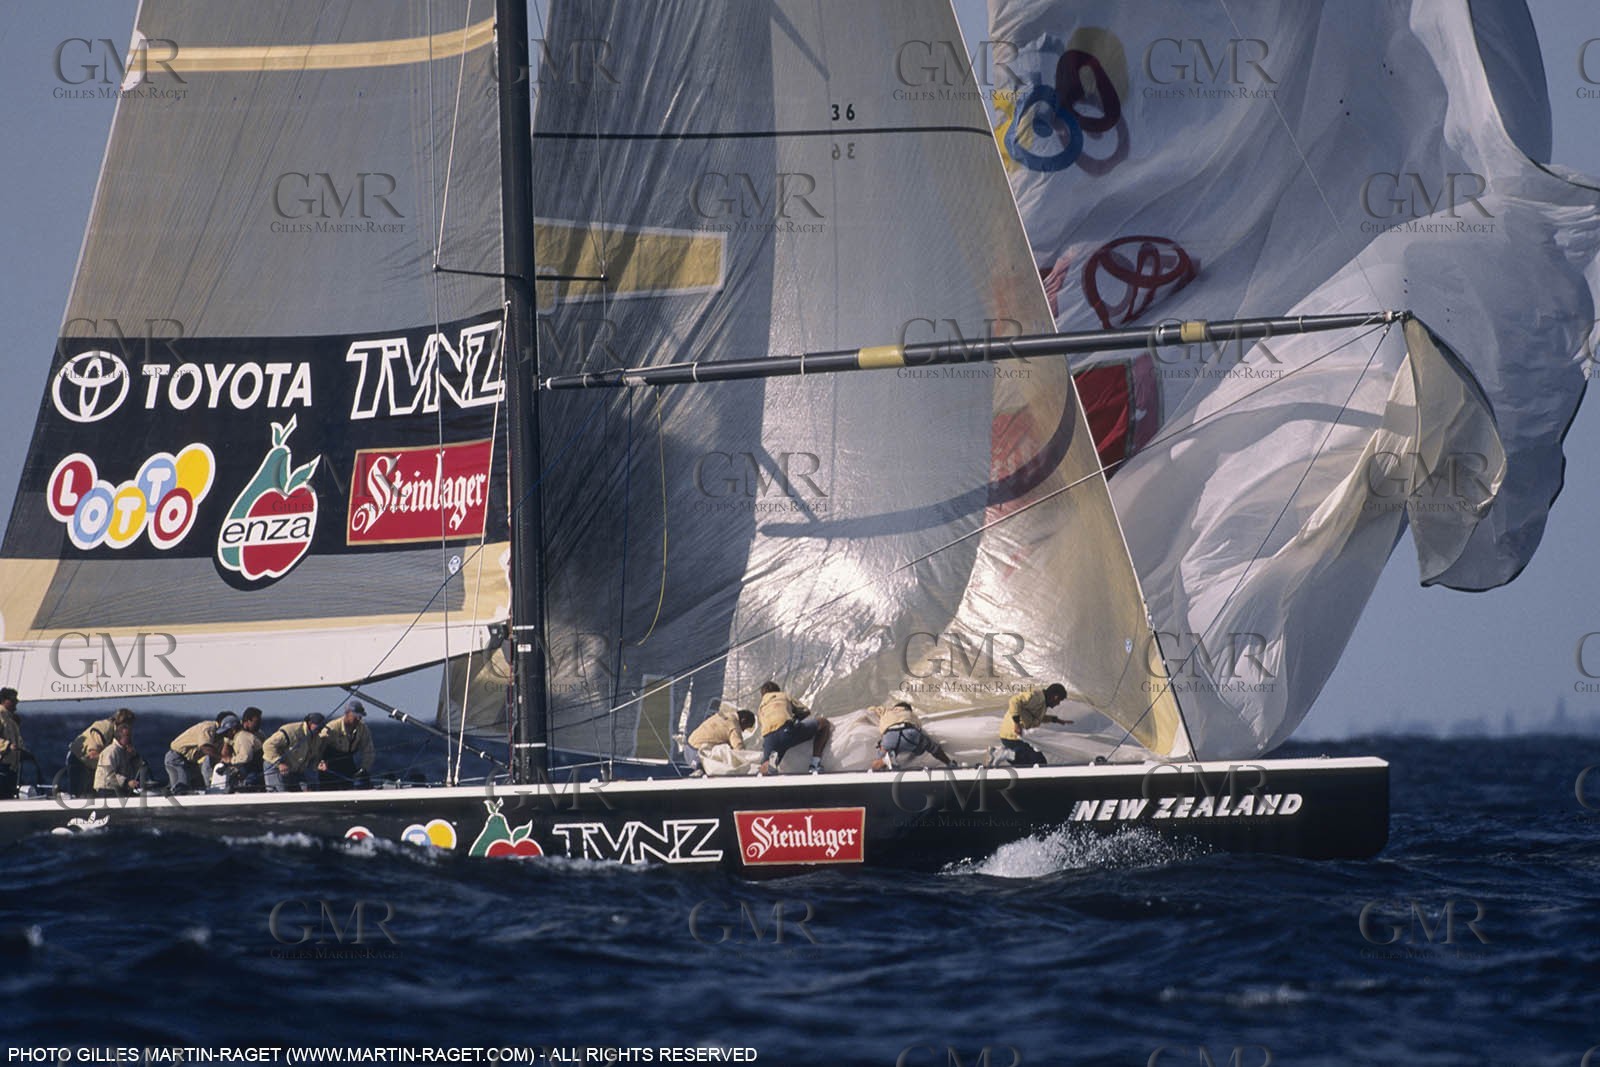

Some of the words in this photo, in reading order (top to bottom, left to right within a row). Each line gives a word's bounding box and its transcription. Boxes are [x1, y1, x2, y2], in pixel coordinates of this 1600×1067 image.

[831, 103, 856, 121] 36
[142, 362, 312, 411] TOYOTA
[346, 320, 506, 420] TVNZ
[57, 464, 192, 538] LOTTO
[352, 450, 486, 534] Steinlager
[222, 516, 312, 545] enza
[1071, 799, 1149, 821] NEW
[1152, 793, 1304, 818] ZEALAND
[552, 819, 723, 865] TVNZ
[746, 815, 858, 859] Steinlager
